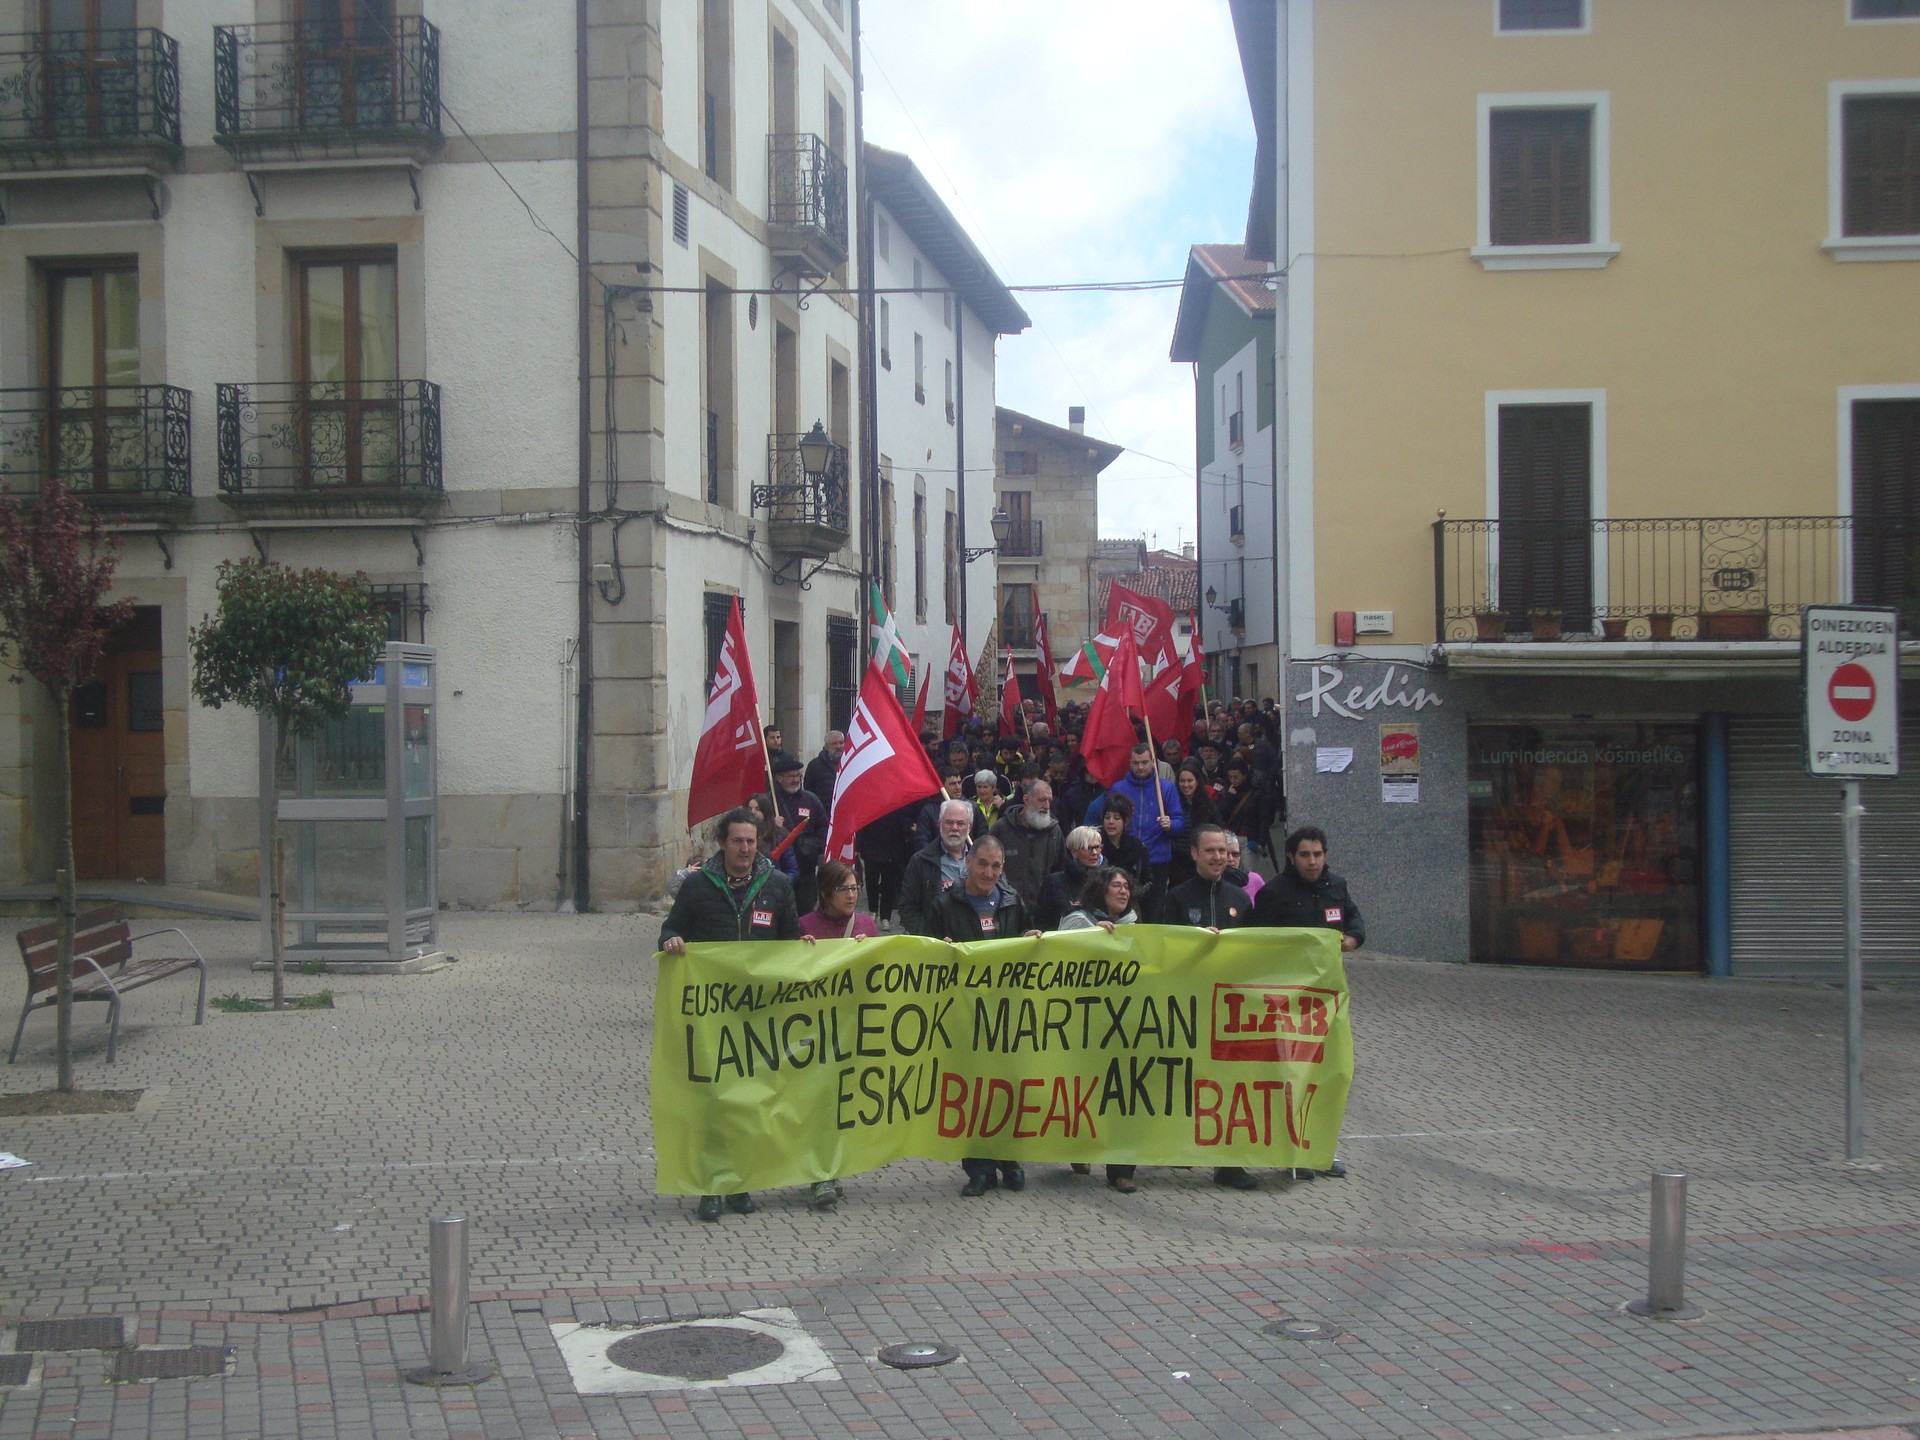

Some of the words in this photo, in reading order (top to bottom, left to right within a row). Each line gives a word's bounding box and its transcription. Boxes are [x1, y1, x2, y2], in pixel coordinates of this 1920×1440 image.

[1811, 618, 1894, 635] OINEZKOEN
[1817, 640, 1887, 655] ALDERDIA
[1295, 665, 1443, 720] Redin
[1832, 730, 1873, 744] ZONA
[1480, 748, 1588, 764] Lurrindenda
[1816, 751, 1891, 766] PETONAL
[681, 982, 767, 1017] EUSKAL
[769, 968, 854, 1006] HERRIA
[865, 962, 959, 994] CONTRA
[964, 964, 992, 989] LA
[1223, 992, 1330, 1037] LAB
[686, 996, 955, 1084] LANGILEOK
[972, 995, 1198, 1053] MARTXAN
